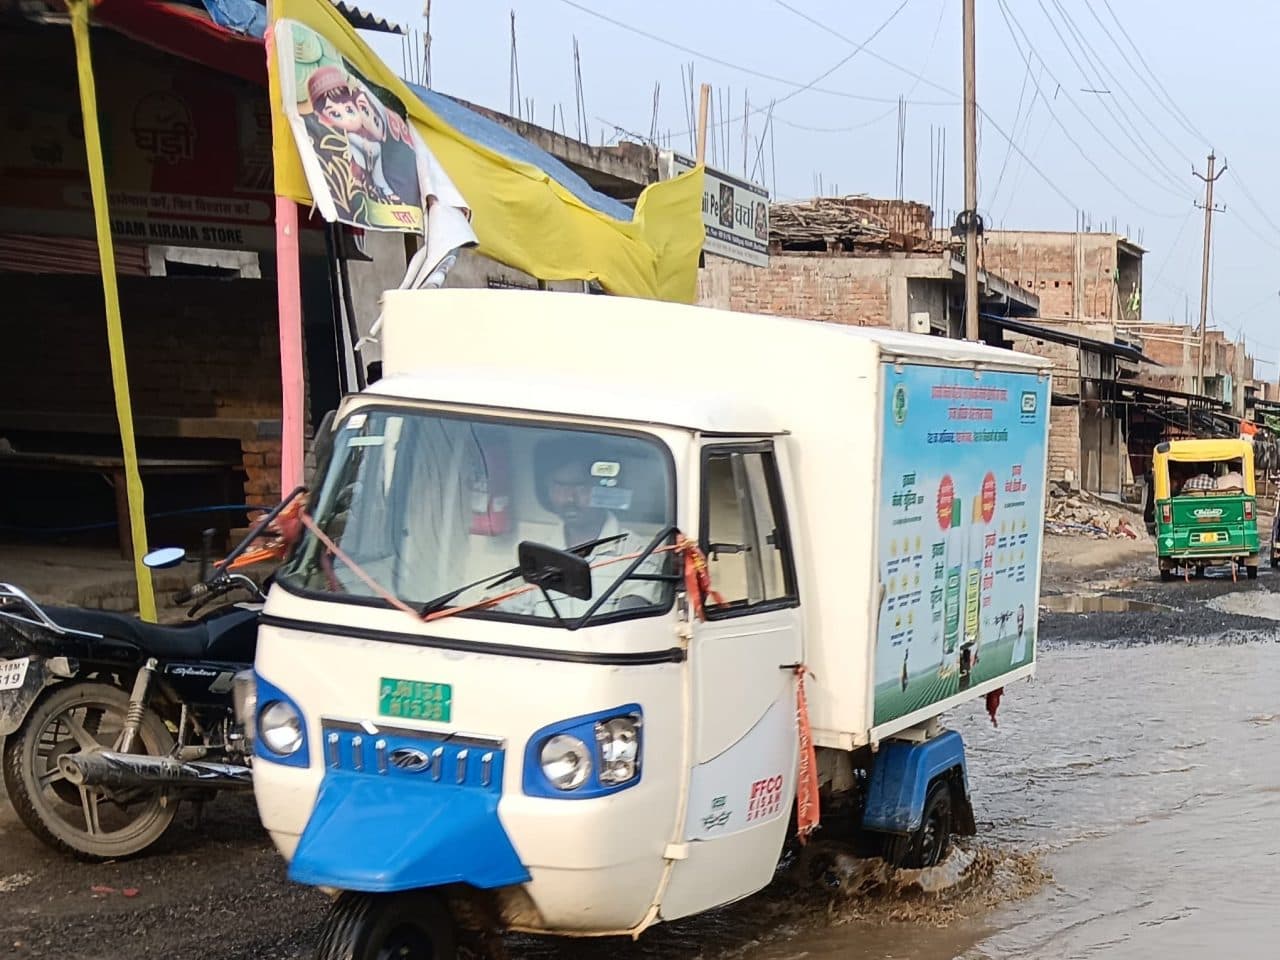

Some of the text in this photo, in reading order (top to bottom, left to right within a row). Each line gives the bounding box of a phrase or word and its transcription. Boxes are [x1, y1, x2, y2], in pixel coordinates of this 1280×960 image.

[149, 223, 198, 241] KIRANA
[202, 226, 243, 244] STORE
[750, 774, 783, 798] IFFCO
